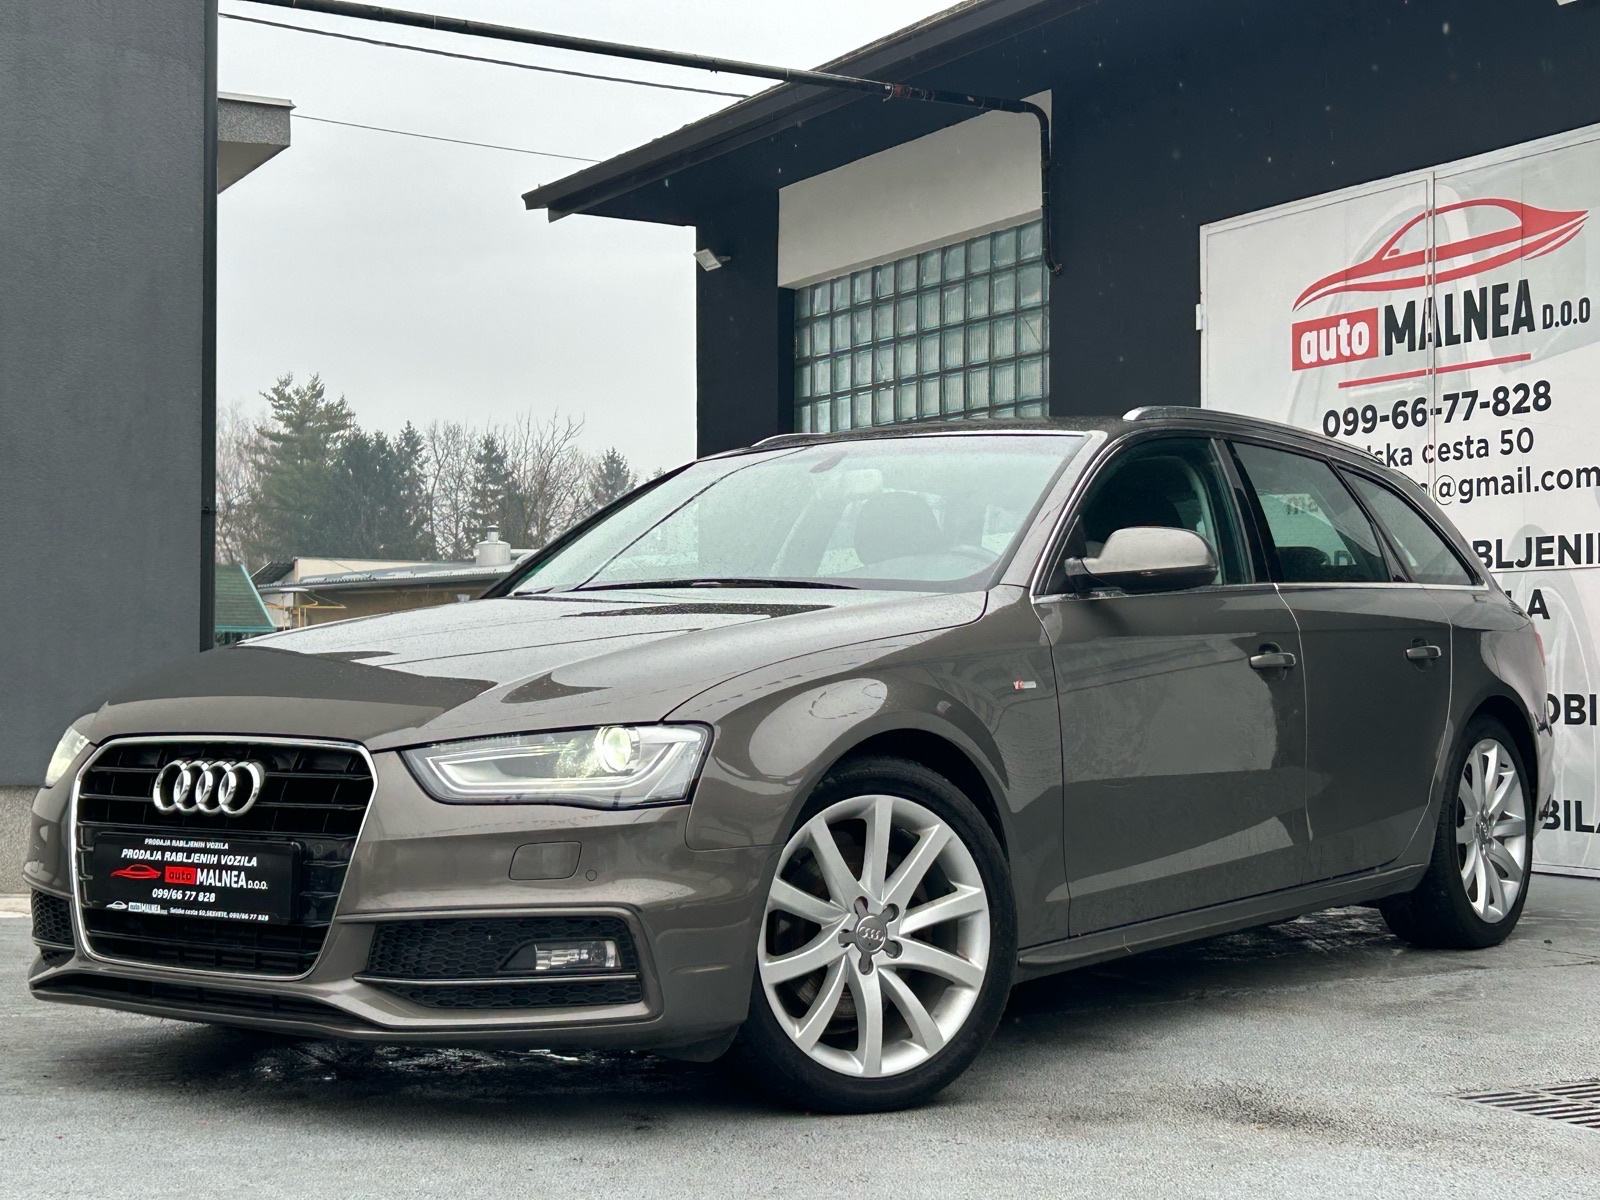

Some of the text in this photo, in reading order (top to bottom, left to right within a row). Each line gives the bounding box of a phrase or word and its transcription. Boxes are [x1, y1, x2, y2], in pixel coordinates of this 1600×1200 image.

[1299, 279, 1591, 366] auto MALNEA D.O.O
[1322, 380, 1552, 438] 099-66-77-828
[1421, 435, 1489, 464] cesta
[1499, 427, 1535, 456] 50
[1472, 532, 1600, 569] BLJENI
[1541, 799, 1600, 834] BIL
[121, 848, 258, 867] PRODAJA RABLJENIH VOZILA
[144, 838, 171, 846] PRODAJA
[206, 842, 229, 850] VOZILA
[152, 888, 216, 903] 099/66 77 828
[168, 870, 192, 881] auto
[196, 867, 247, 889] MALNEA
